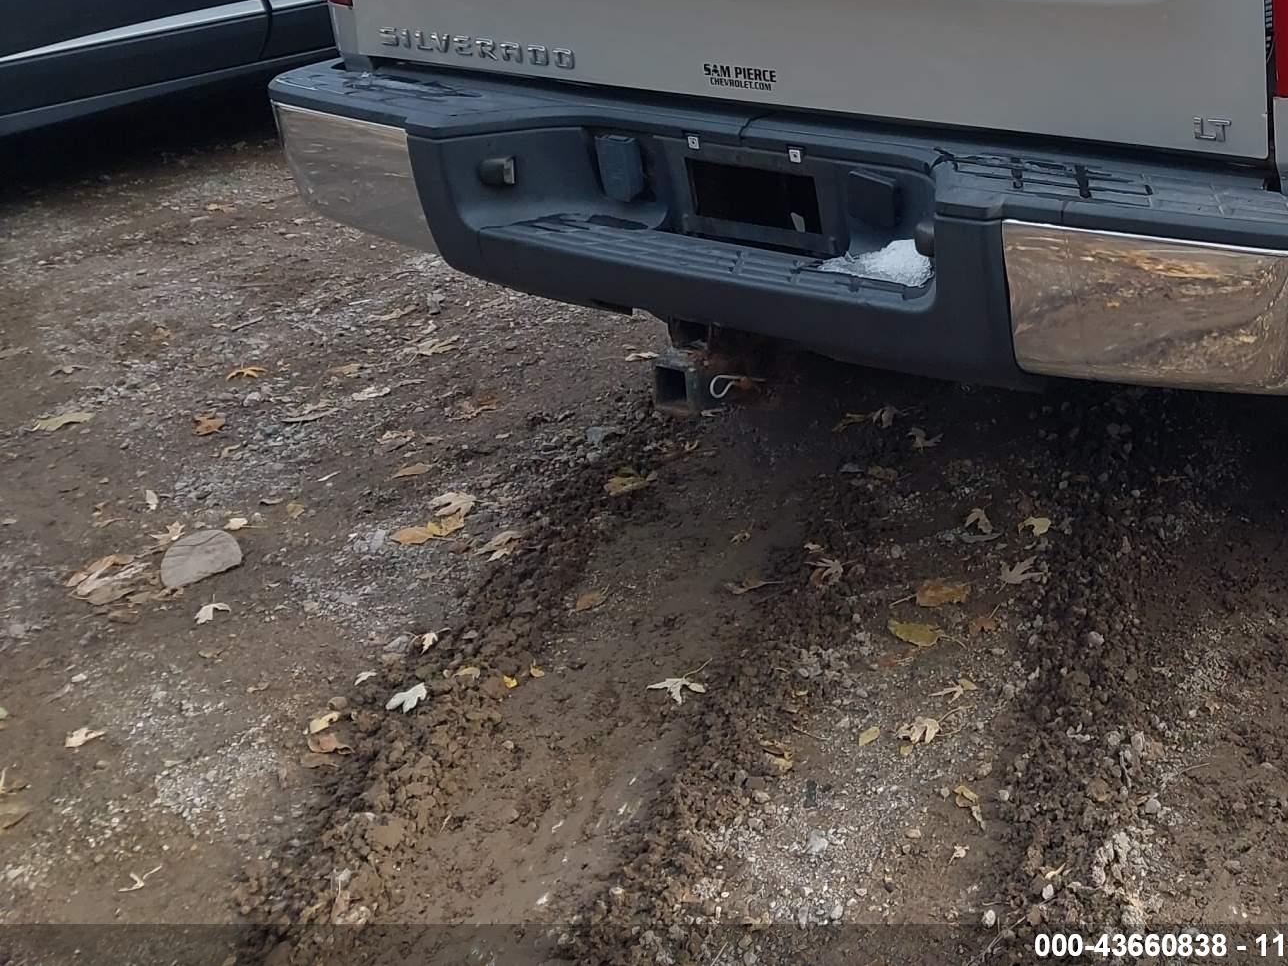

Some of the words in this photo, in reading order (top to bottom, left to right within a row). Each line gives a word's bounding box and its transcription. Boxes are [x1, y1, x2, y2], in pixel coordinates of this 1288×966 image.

[378, 26, 576, 70] SILVERADO
[703, 63, 732, 78] SAM
[734, 66, 777, 83] PIERCE
[709, 77, 773, 92] CHEVROLET.COM
[1193, 117, 1232, 142] LT
